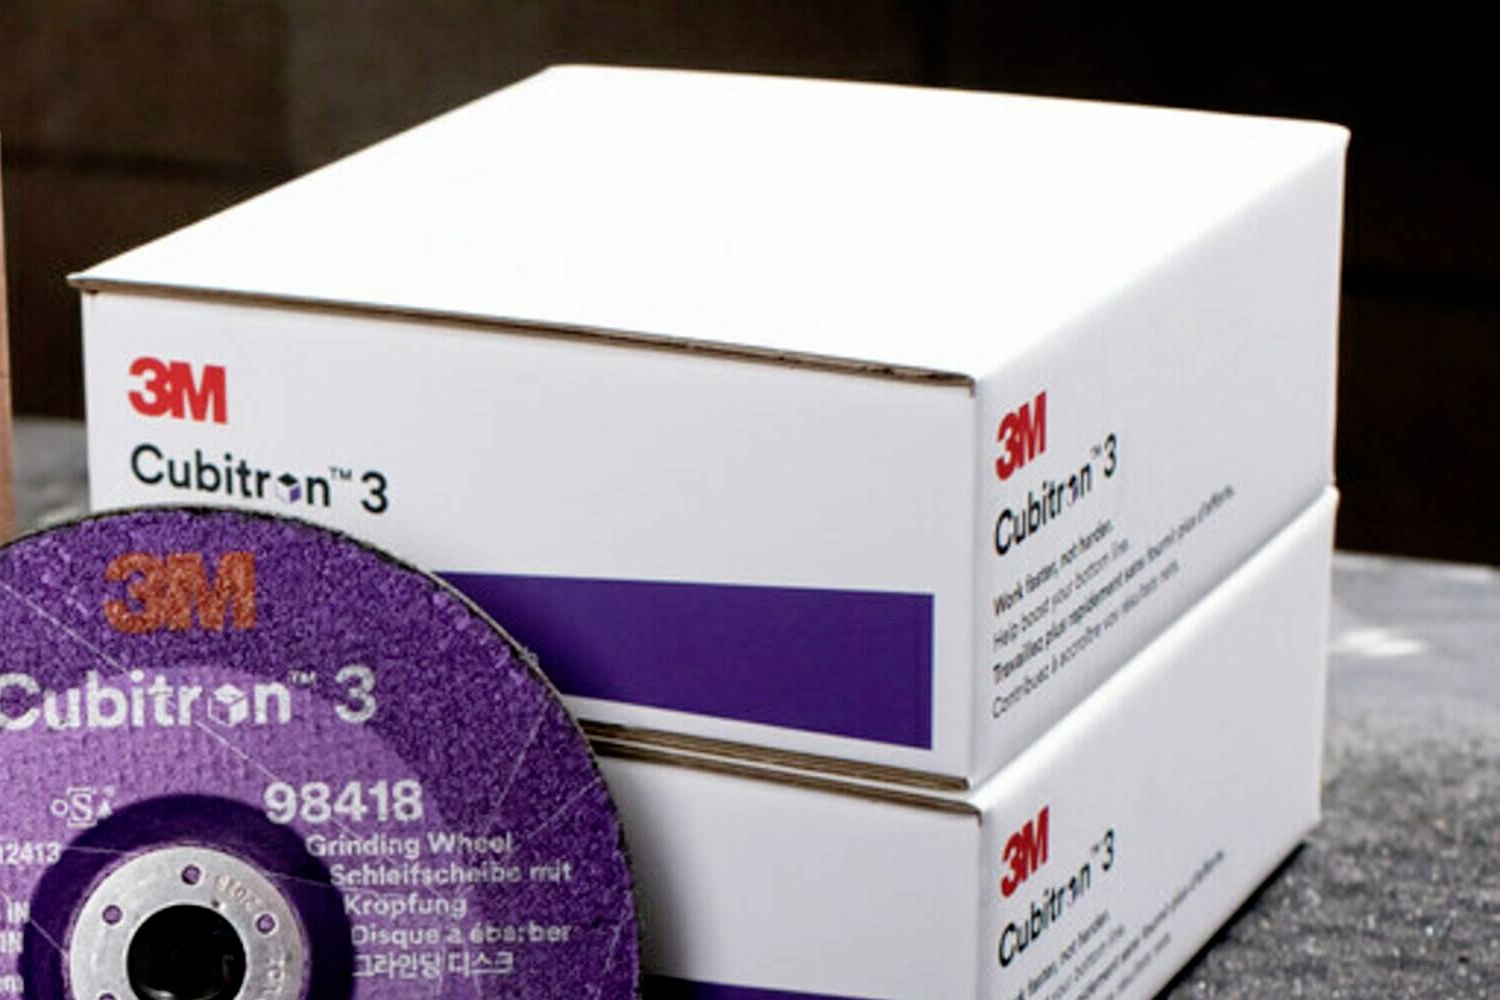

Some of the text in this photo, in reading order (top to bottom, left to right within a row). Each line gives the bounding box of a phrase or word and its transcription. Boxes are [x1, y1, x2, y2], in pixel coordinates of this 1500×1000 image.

[128, 357, 228, 424] 3M
[996, 391, 1047, 480] 3M
[1103, 432, 1117, 478] 3
[361, 471, 388, 514] 3
[104, 551, 257, 633] 3M
[994, 580, 1023, 616] Work
[335, 665, 378, 724] 3
[264, 780, 423, 825] 98418
[306, 830, 513, 860] Grinding Wheel
[1001, 805, 1049, 898] 3M
[1101, 828, 1114, 871] 3
[330, 861, 521, 887] Schleifscheibe
[351, 924, 440, 949] Disque
